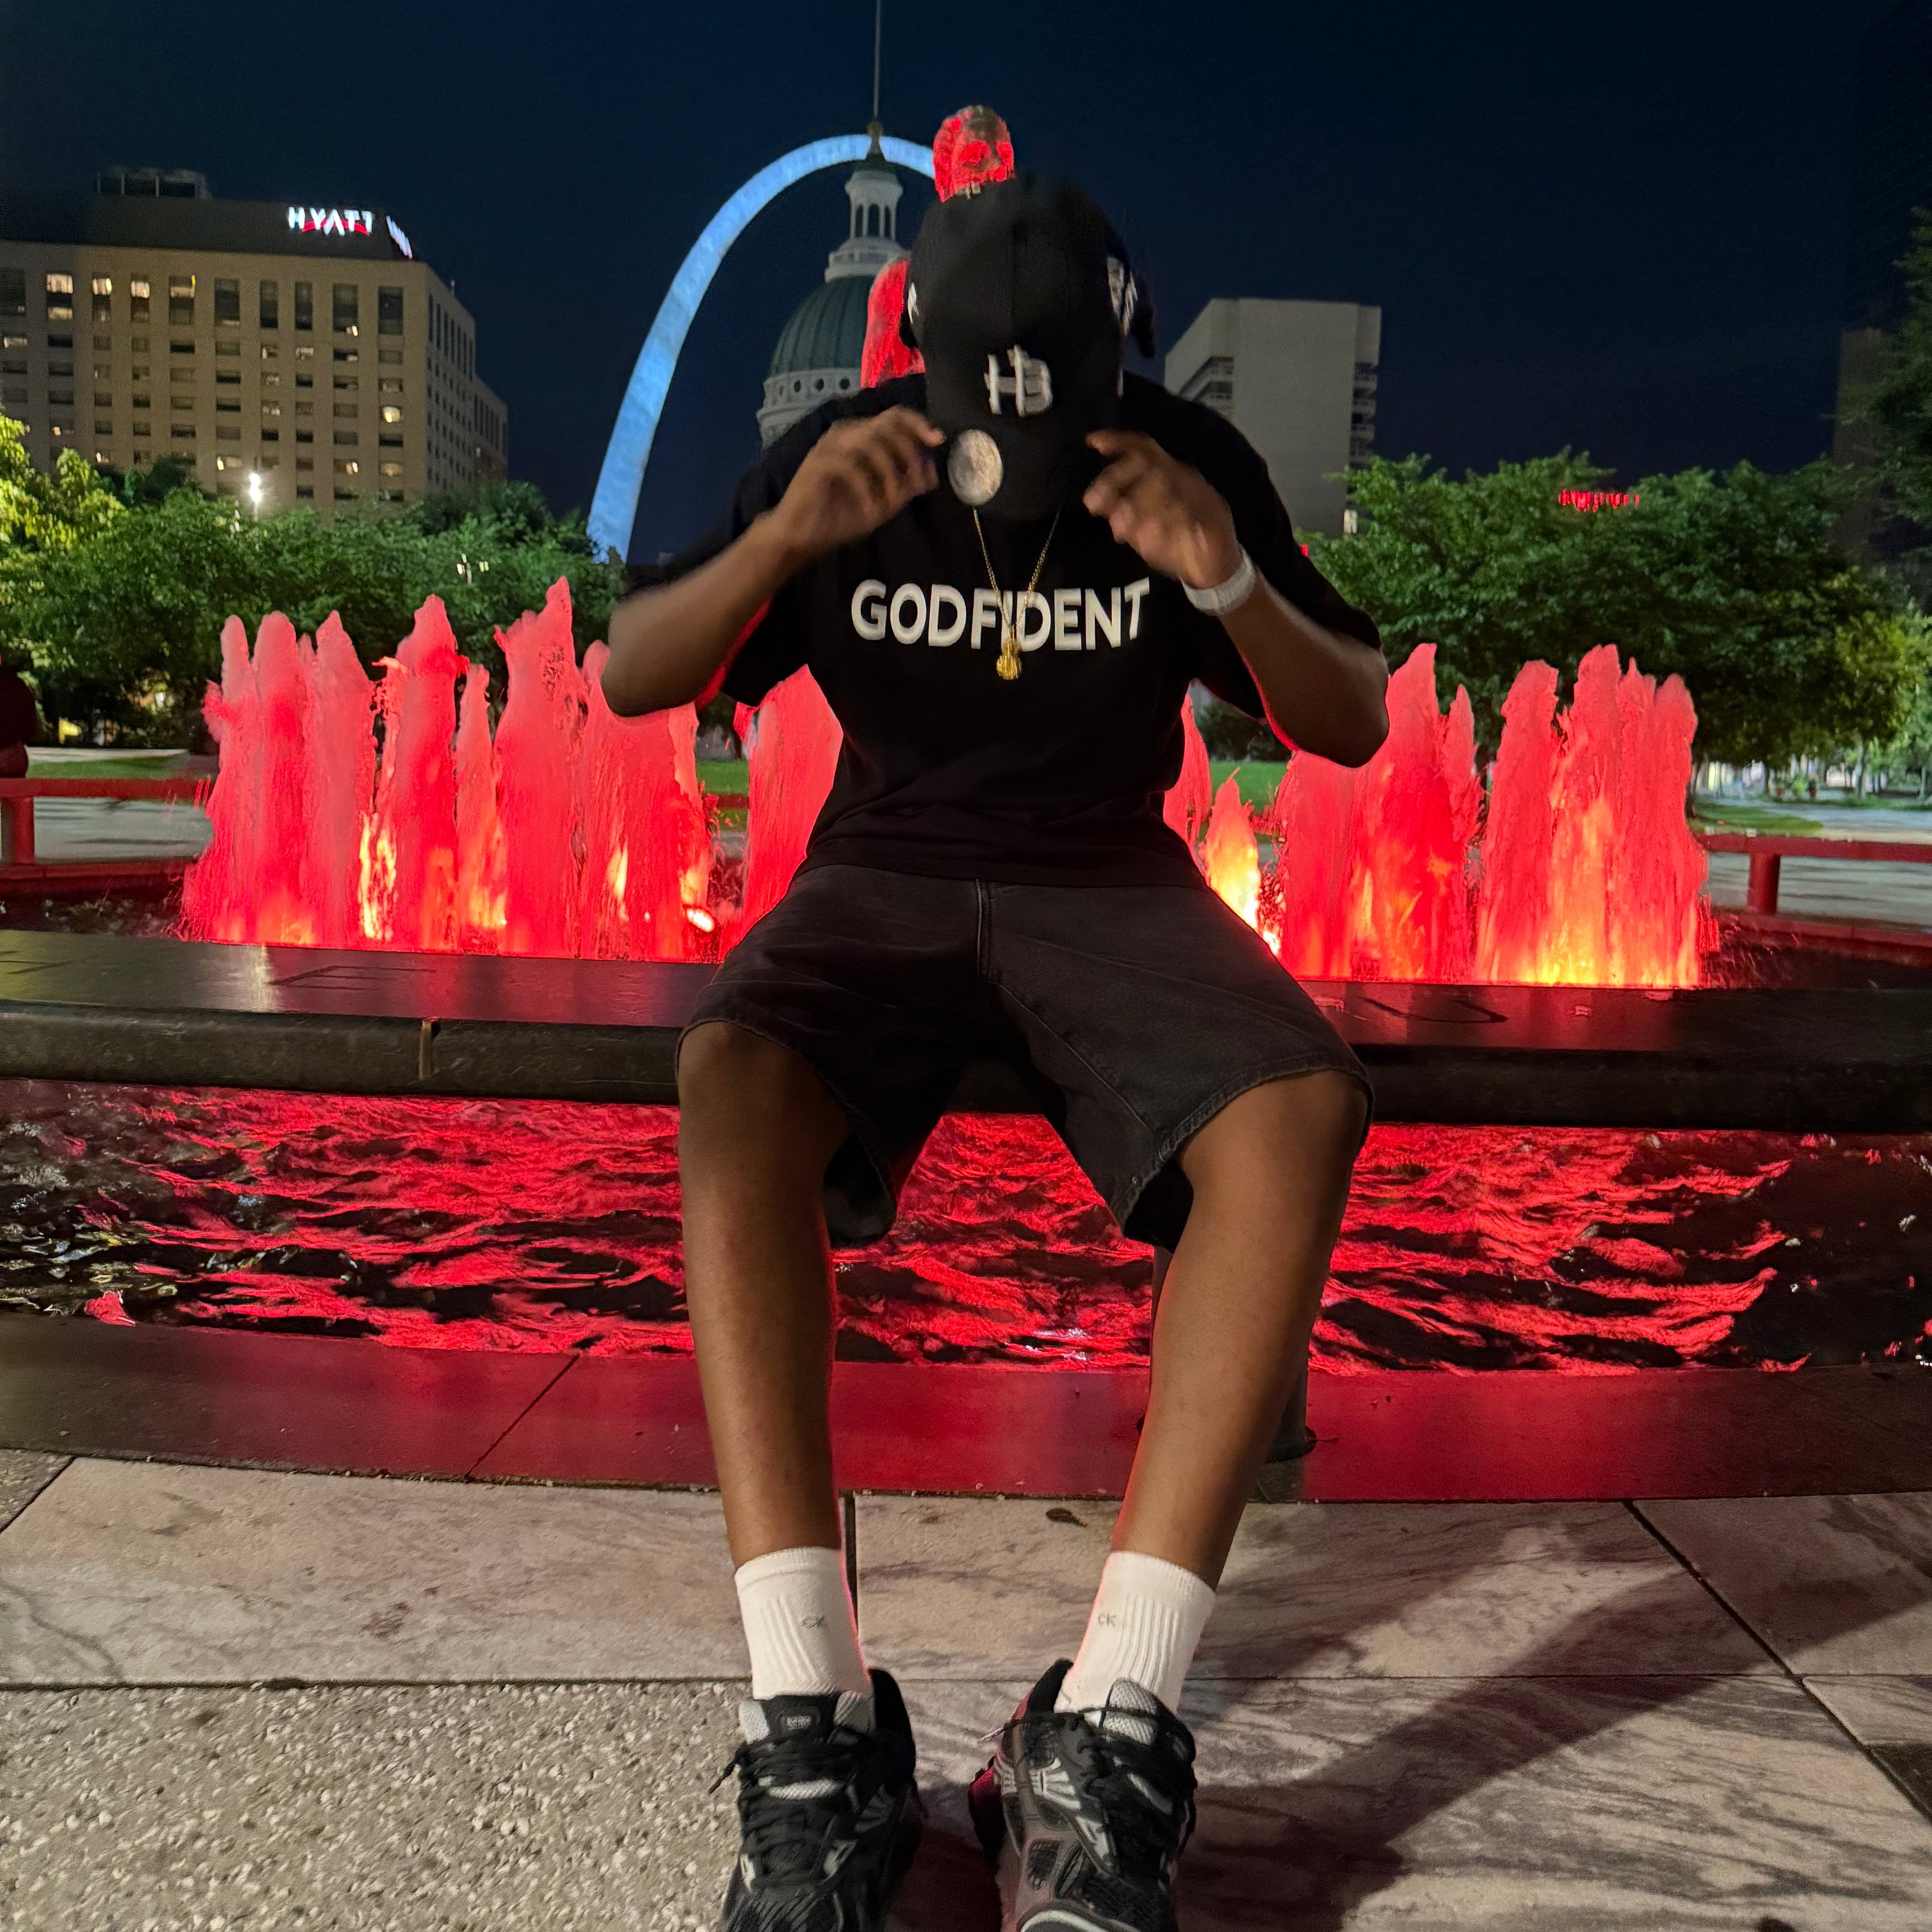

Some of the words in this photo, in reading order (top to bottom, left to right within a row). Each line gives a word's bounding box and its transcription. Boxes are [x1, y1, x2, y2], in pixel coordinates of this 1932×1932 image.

[288, 206, 372, 235] HYATT
[851, 577, 1150, 652] GODFIDENT
[1098, 1614, 1115, 1627] CK
